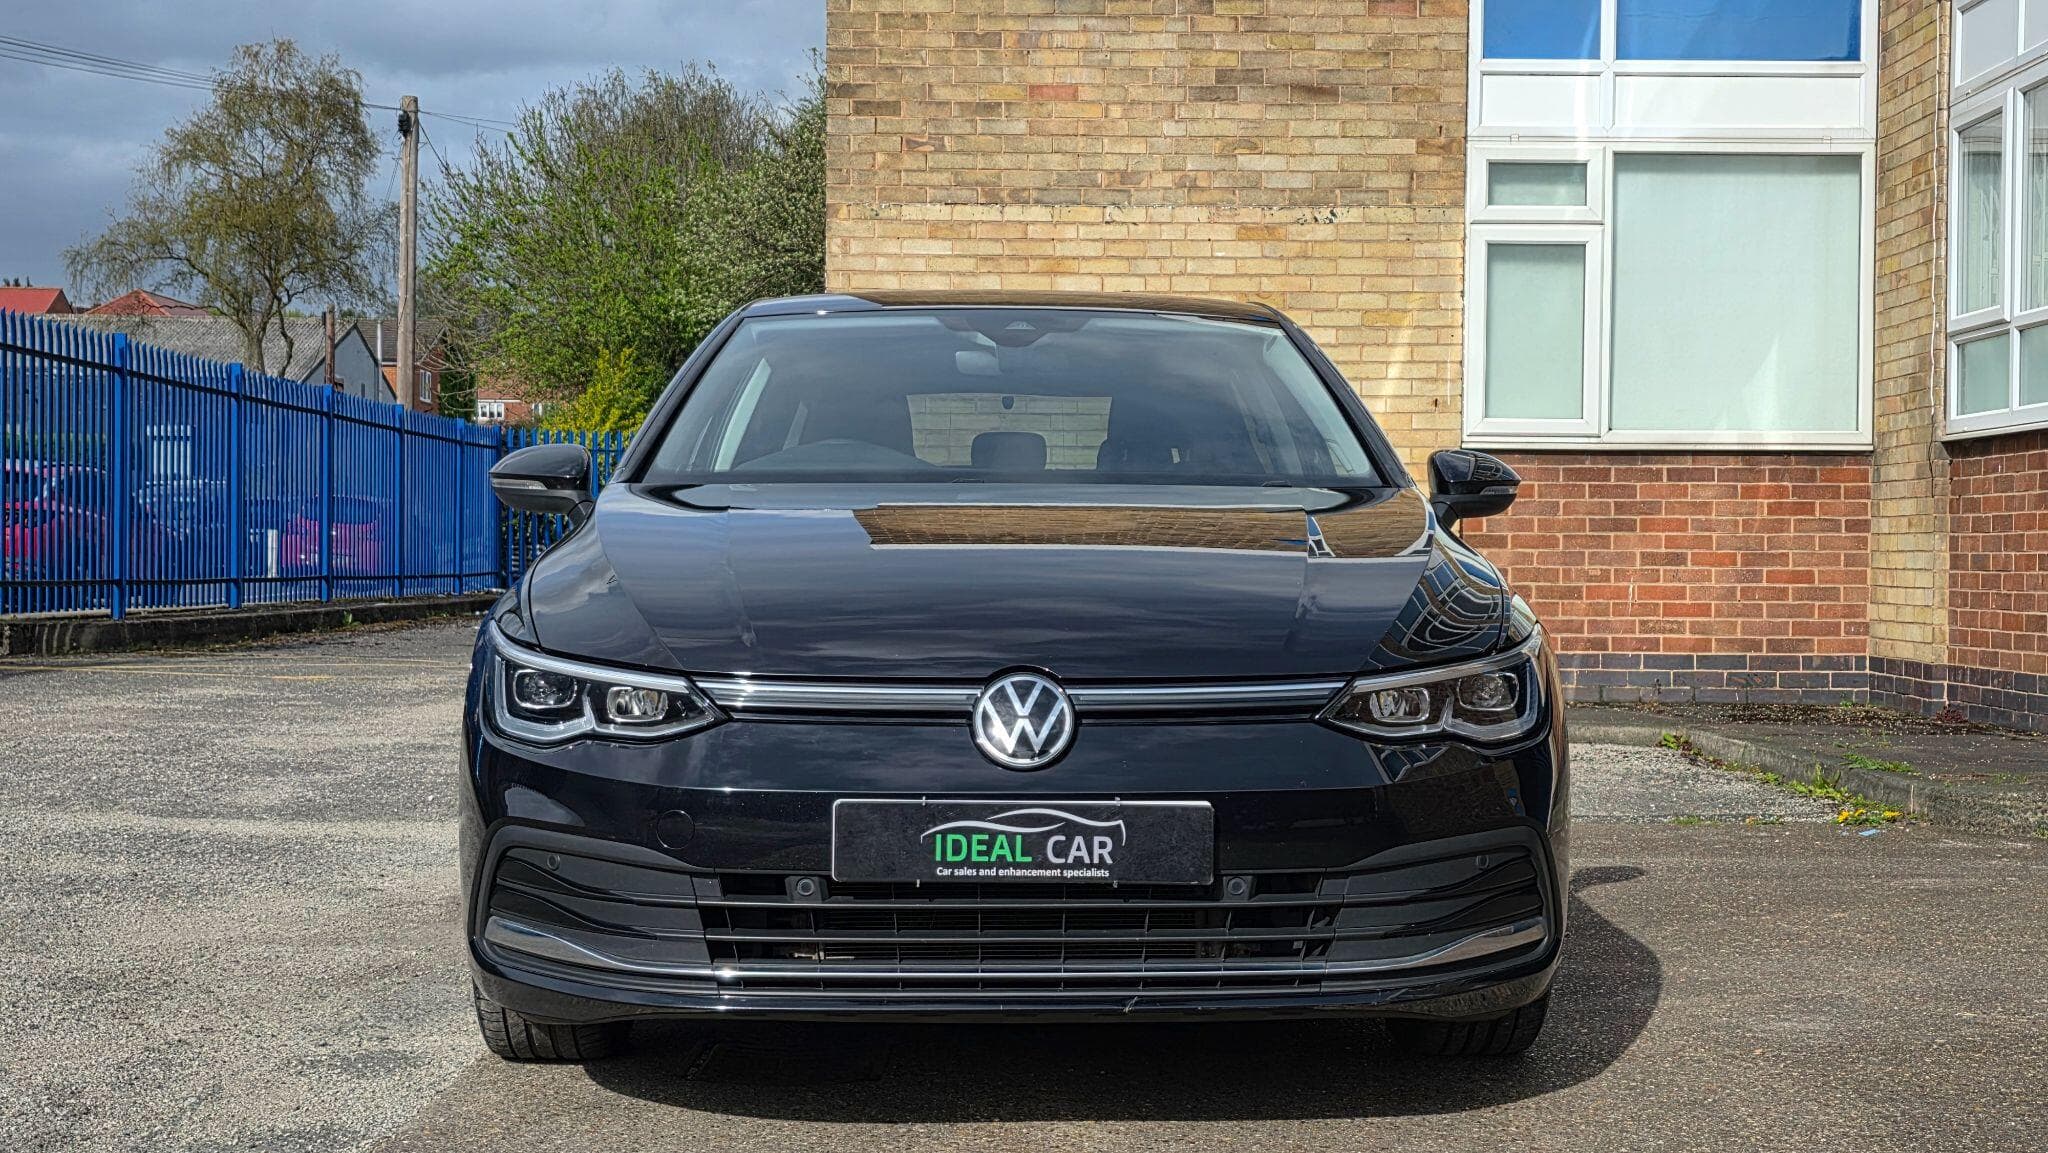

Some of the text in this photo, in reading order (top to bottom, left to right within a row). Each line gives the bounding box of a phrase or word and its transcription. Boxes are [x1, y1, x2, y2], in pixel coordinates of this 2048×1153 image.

[981, 676, 1067, 757] VW
[935, 834, 1113, 864] IDEAL CAR
[936, 867, 1110, 878] Car sales and enhancement specialists
